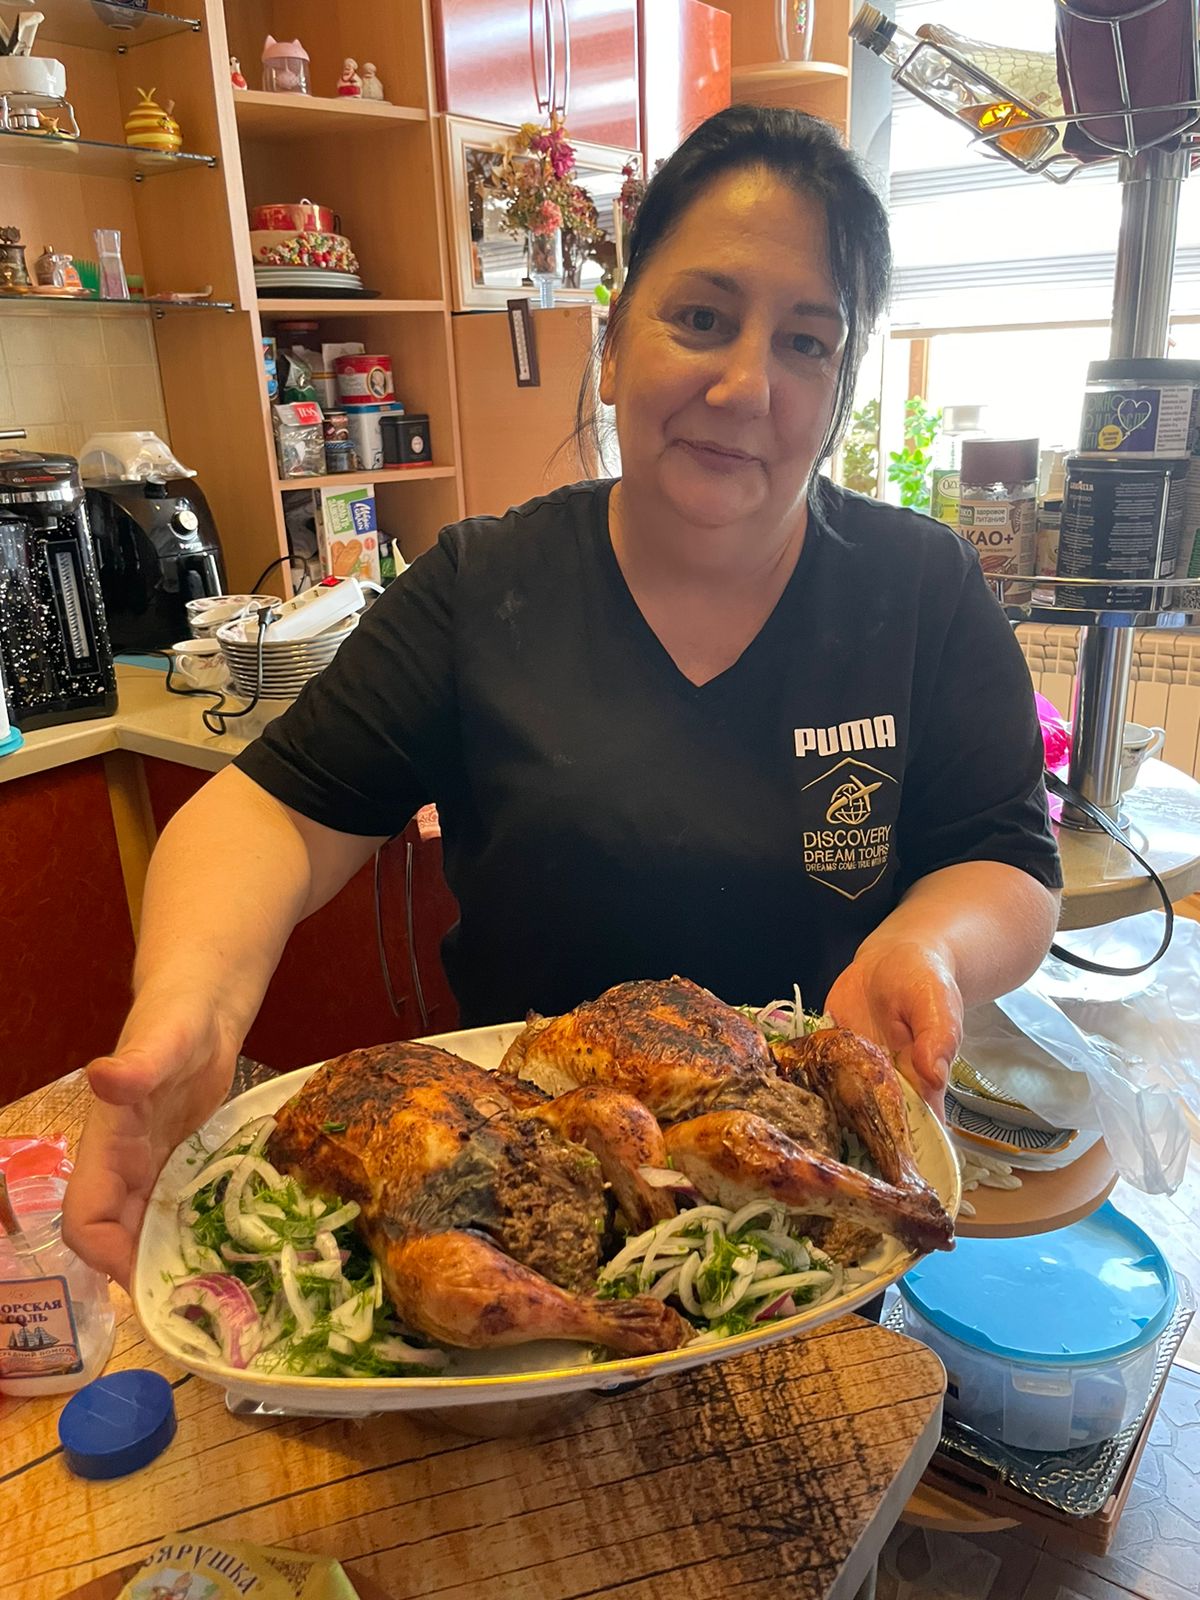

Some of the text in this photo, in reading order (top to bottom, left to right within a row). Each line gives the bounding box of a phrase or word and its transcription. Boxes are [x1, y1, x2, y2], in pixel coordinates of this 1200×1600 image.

[961, 530, 1014, 546] КАО+
[794, 714, 896, 757] PUMA
[803, 824, 892, 848] DISCOVERY
[804, 843, 889, 863] DREAM TOURS
[805, 862, 837, 872] DREAMS
[838, 861, 857, 870] COME
[857, 859, 871, 869] TRUE
[0, 1300, 62, 1313] ОРСКАЯ
